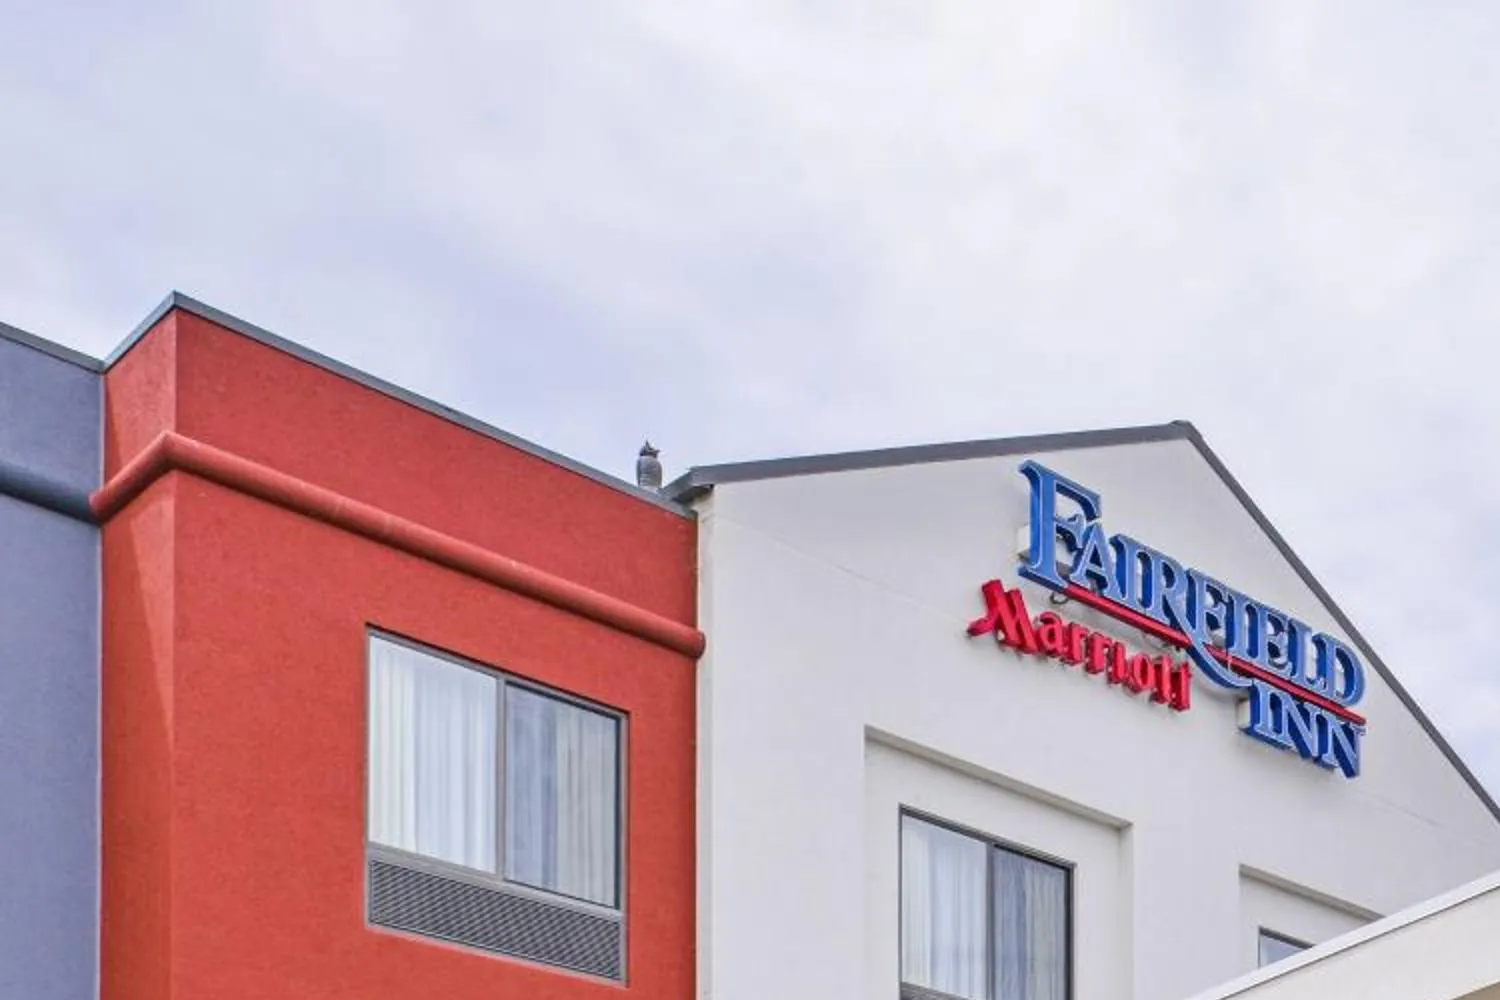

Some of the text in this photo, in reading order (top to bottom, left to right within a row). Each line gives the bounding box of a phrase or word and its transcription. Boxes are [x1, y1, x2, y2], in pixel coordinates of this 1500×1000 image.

[966, 579, 1193, 712] Marriott
[1017, 459, 1366, 711] FAIRFIELD
[1244, 682, 1366, 779] INN
